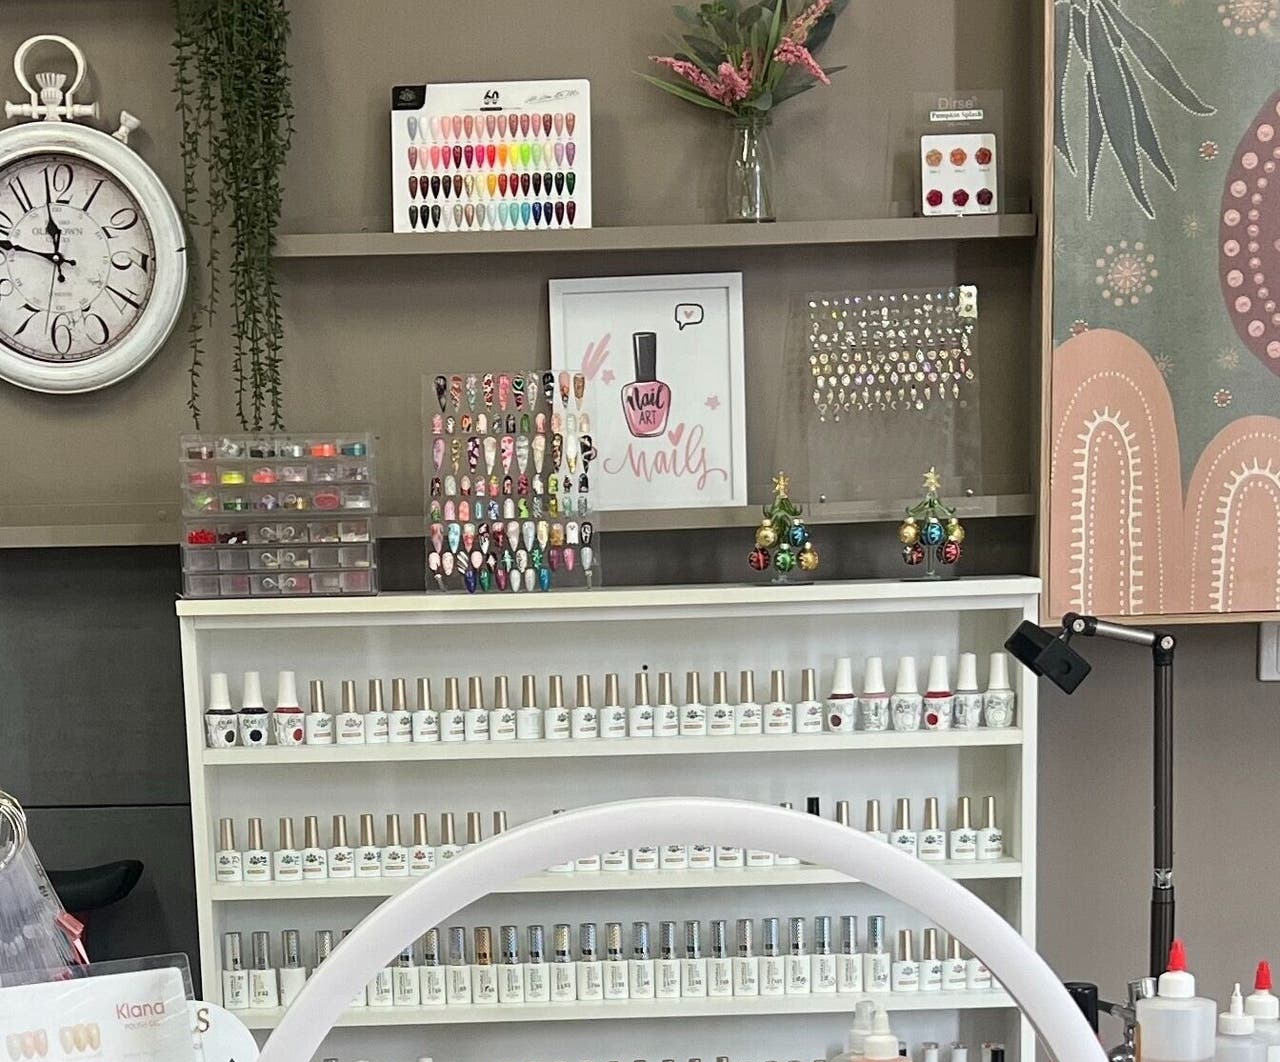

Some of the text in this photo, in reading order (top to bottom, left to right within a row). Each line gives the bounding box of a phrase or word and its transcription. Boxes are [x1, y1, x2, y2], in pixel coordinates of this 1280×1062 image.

[8, 176, 34, 214] 11
[40, 163, 74, 204] 12
[82, 178, 108, 212] 1
[101, 207, 139, 239] 2
[110, 248, 149, 274] 3
[104, 284, 142, 316] 4
[12, 303, 41, 337] 7
[50, 312, 73, 355] 6
[80, 304, 110, 346] 5
[626, 385, 665, 411] Nail
[638, 410, 657, 425] ART
